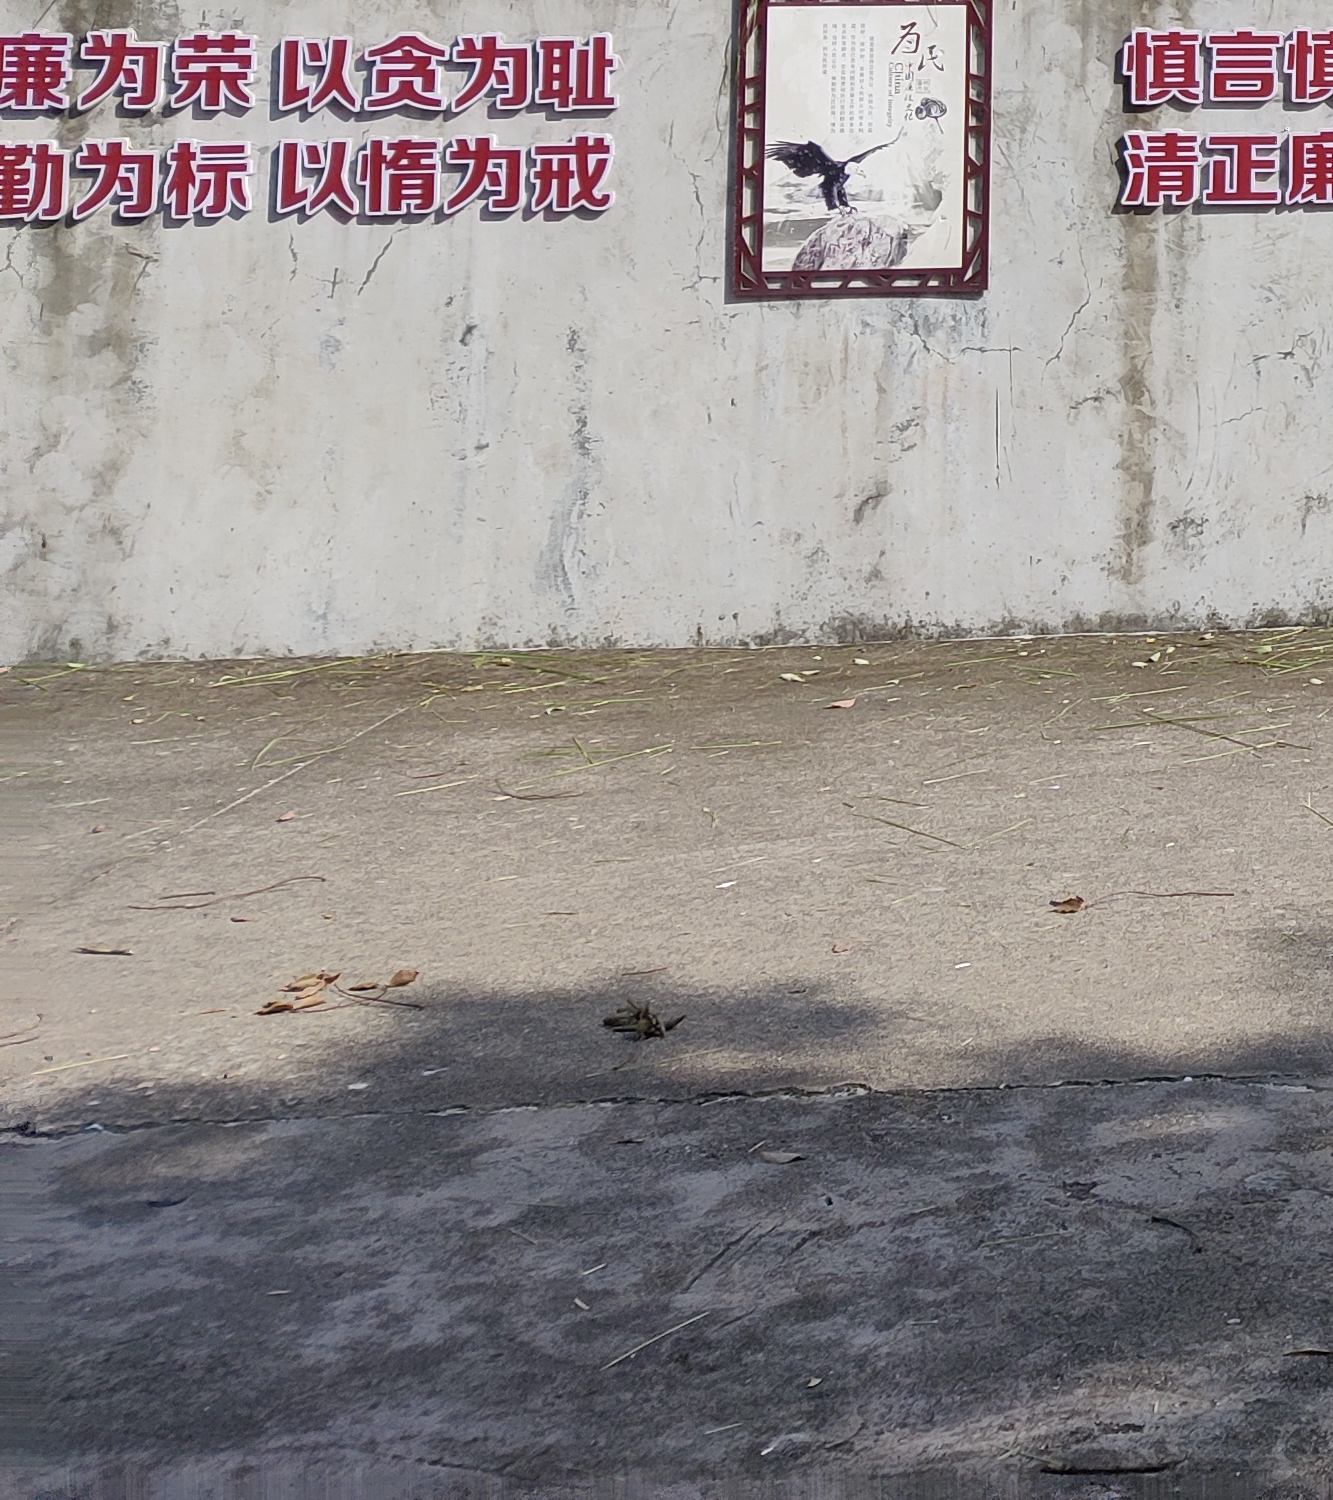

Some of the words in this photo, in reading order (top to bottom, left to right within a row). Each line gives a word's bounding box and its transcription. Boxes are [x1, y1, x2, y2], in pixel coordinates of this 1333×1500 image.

[0, 29, 258, 111] 廉为荣
[276, 31, 619, 112] 以贪为耻
[894, 62, 904, 94] China
[0, 136, 253, 221] 勤为标
[276, 132, 617, 218] 以惰为戒
